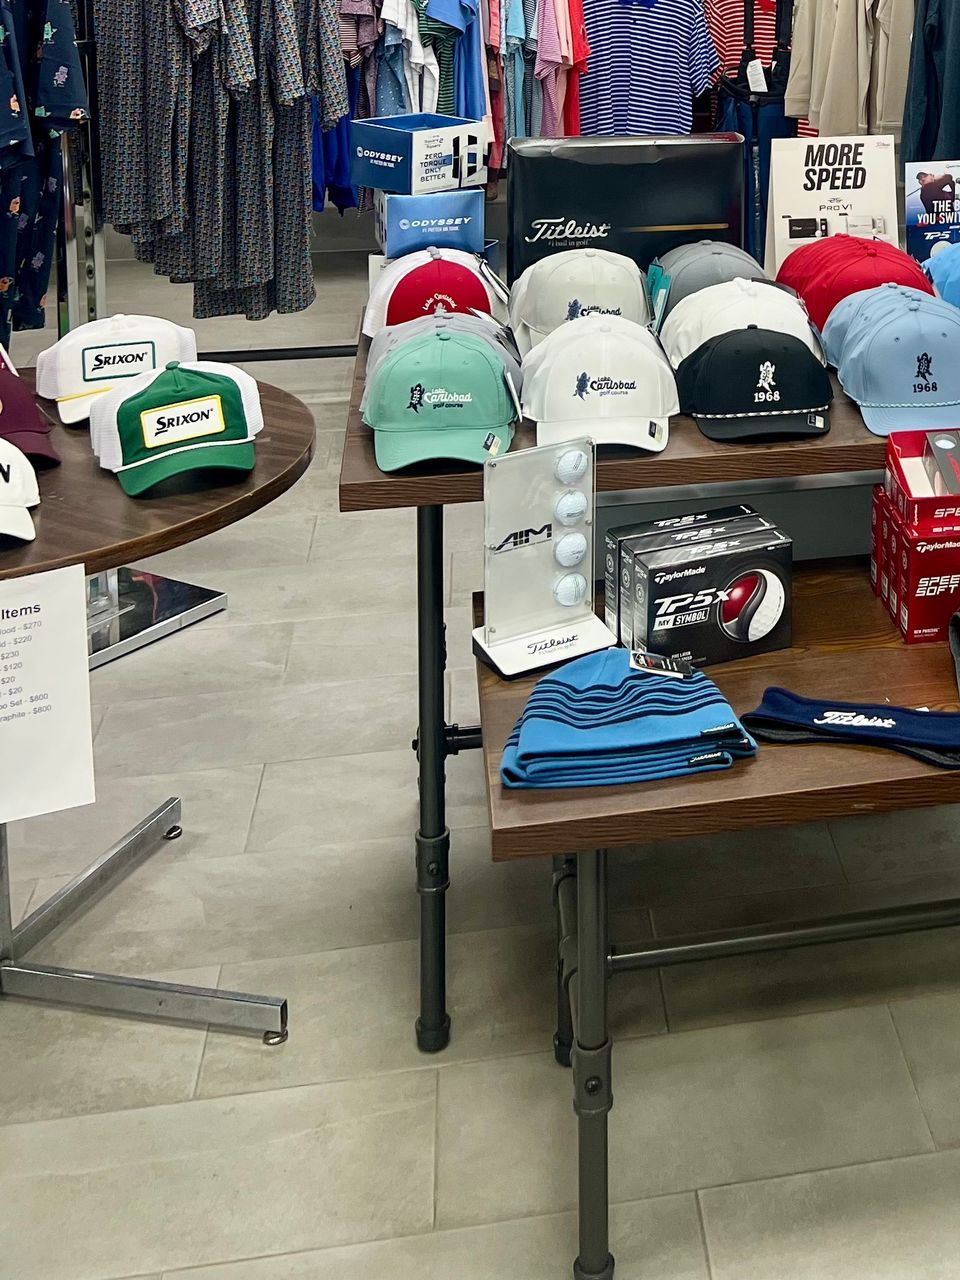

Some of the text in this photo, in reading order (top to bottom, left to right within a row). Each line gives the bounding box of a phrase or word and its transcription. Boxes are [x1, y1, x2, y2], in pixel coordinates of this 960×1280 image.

[363, 150, 403, 163] ODYSSEY
[424, 152, 443, 160] ZERO
[804, 143, 865, 167] MORE
[420, 158, 447, 168] TORQUE
[424, 167, 441, 175] ONLY
[420, 173, 446, 182] BETTER
[803, 166, 867, 191] SPEED
[932, 200, 952, 213] THE
[411, 217, 472, 227] ODYSSEY
[917, 213, 936, 225] YOU
[525, 217, 610, 243] Titleist
[92, 352, 148, 371] SRIXON
[590, 380, 636, 391] Carlsbad
[912, 382, 938, 393] 1968
[424, 392, 472, 403] Carlsbad
[753, 391, 781, 402] 1968
[154, 408, 213, 437] SRIXON
[495, 523, 552, 552] AIM
[654, 566, 706, 585] TaylorMade
[915, 584, 959, 597] SOFT
[654, 588, 733, 616] TP5x
[2, 604, 41, 620] Items
[657, 610, 708, 627] MY SYMBOL
[0, 620, 42, 635] ood $270
[14, 635, 32, 645] $220
[527, 635, 579, 655] Titleist
[1, 650, 20, 661] $230
[3, 662, 23, 672] $120
[1, 676, 16, 685] $20
[8, 686, 23, 695] $20
[10, 699, 23, 707] Set
[0, 711, 26, 721] raphite
[812, 710, 896, 728] Titleist
